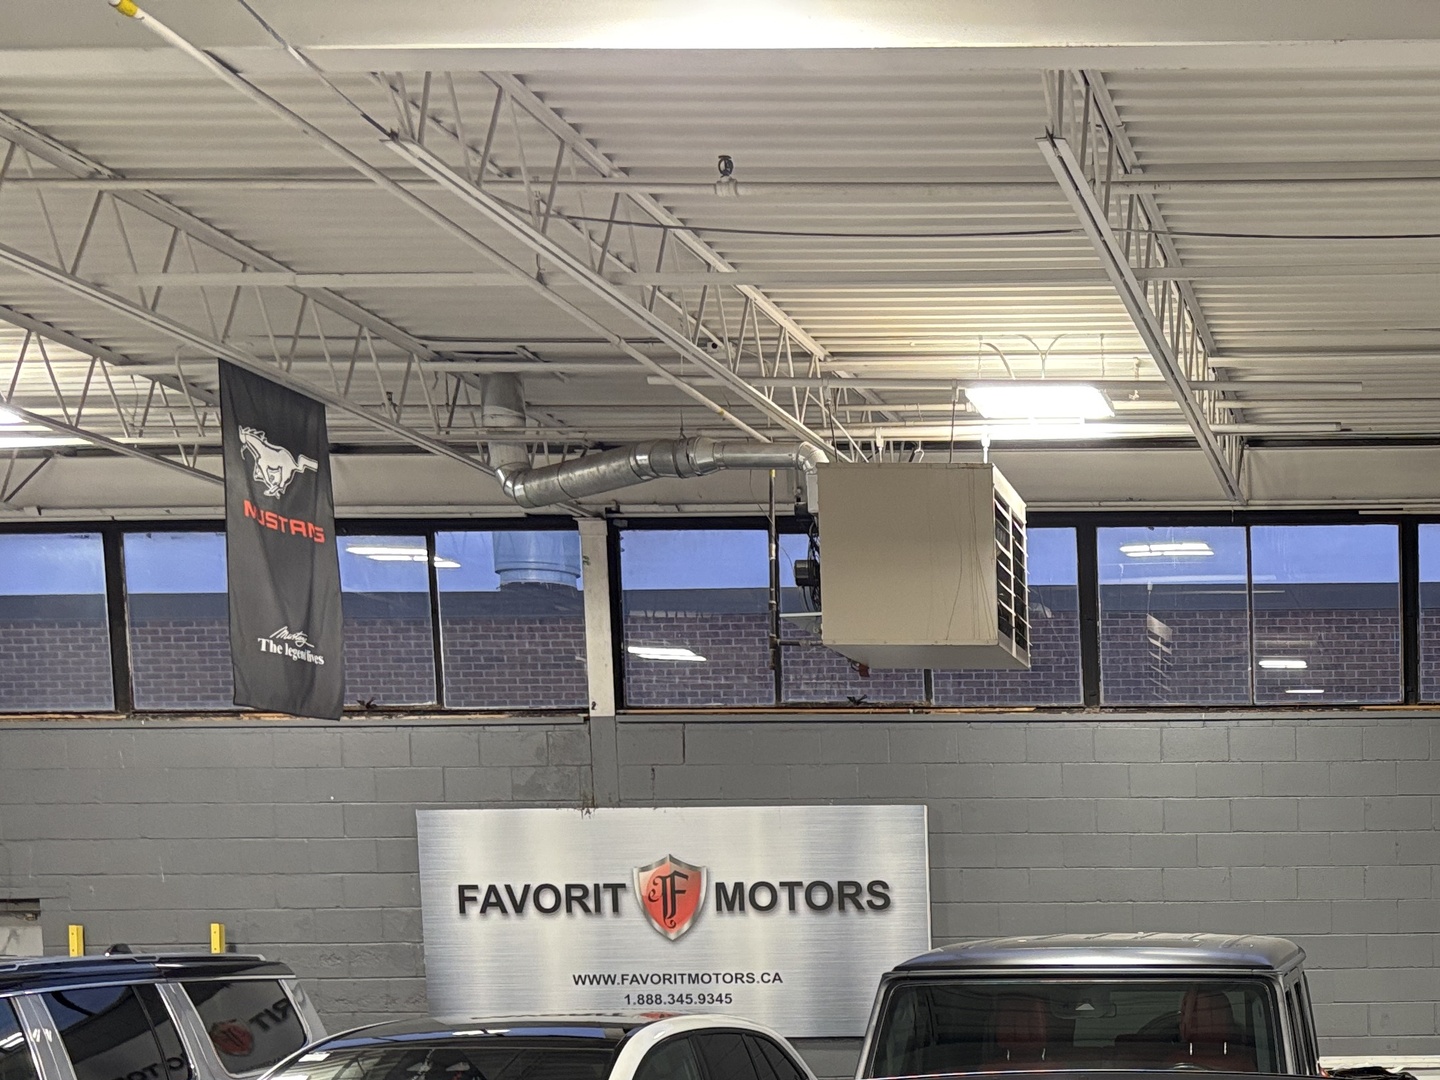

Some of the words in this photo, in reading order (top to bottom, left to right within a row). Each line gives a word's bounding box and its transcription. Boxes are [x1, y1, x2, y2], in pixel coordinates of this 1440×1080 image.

[257, 637, 283, 654] The
[457, 882, 626, 915] FAVORIT
[715, 879, 891, 912] MOTORS
[572, 971, 784, 987] WWW.FAVORITMOTORS.CA
[624, 992, 733, 1006] 1.888.345.9345
